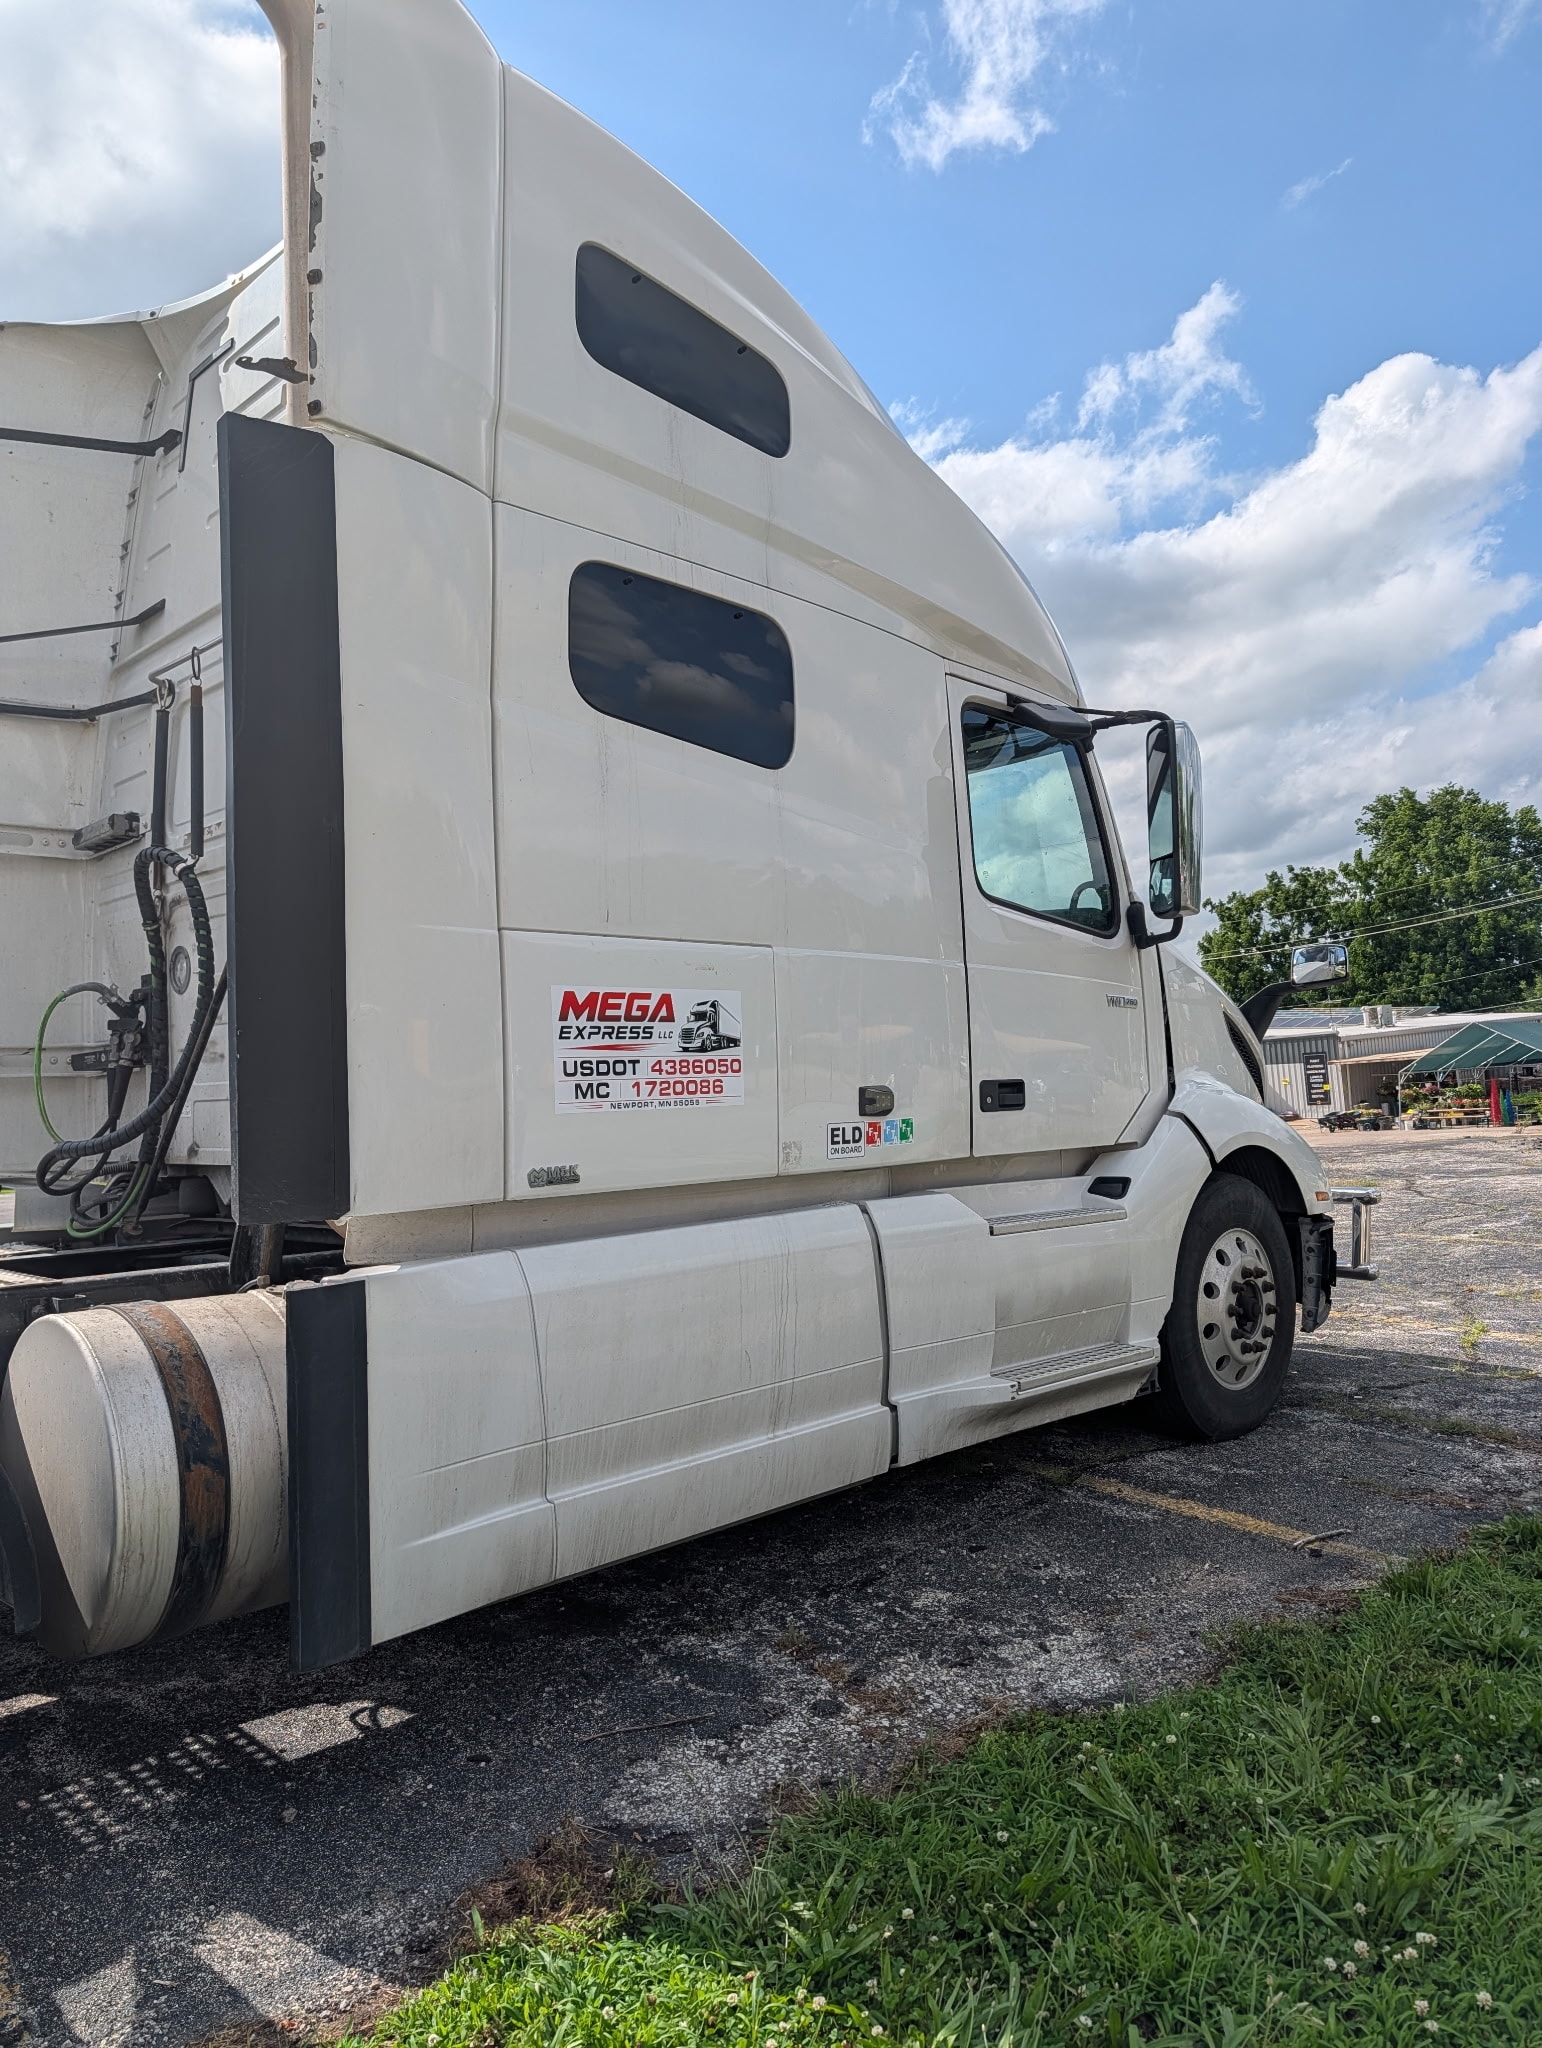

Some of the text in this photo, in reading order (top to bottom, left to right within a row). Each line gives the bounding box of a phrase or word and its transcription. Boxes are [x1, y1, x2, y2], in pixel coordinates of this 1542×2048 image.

[558, 990, 676, 1023] MEGA
[558, 1025, 674, 1041] EXPRESS LLC
[562, 1058, 742, 1078] USDOT 4386050
[574, 1079, 724, 1100] MC 1720086
[610, 1101, 657, 1110] NEWPORT,
[658, 1100, 672, 1108] MN
[830, 1126, 863, 1146] ELD
[830, 1145, 863, 1155] ON BOARD
